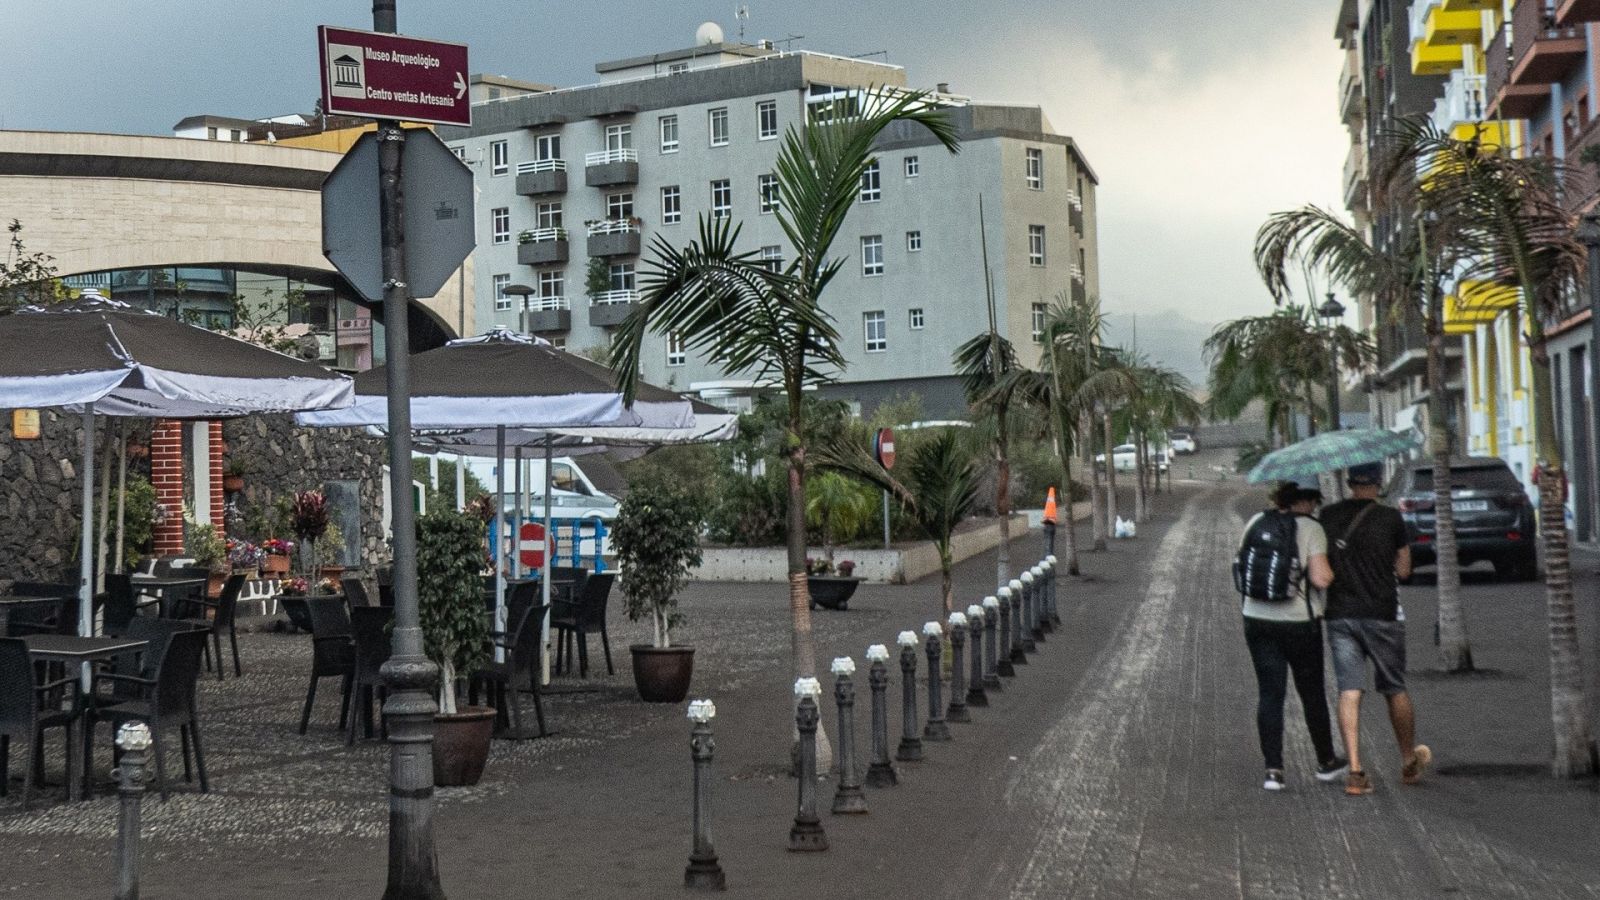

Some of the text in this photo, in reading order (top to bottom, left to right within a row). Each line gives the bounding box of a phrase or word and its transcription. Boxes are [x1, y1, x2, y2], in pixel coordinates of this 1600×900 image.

[365, 47, 440, 69] Museo Arqueológico
[367, 86, 392, 101] Centro
[393, 91, 418, 103] ventas
